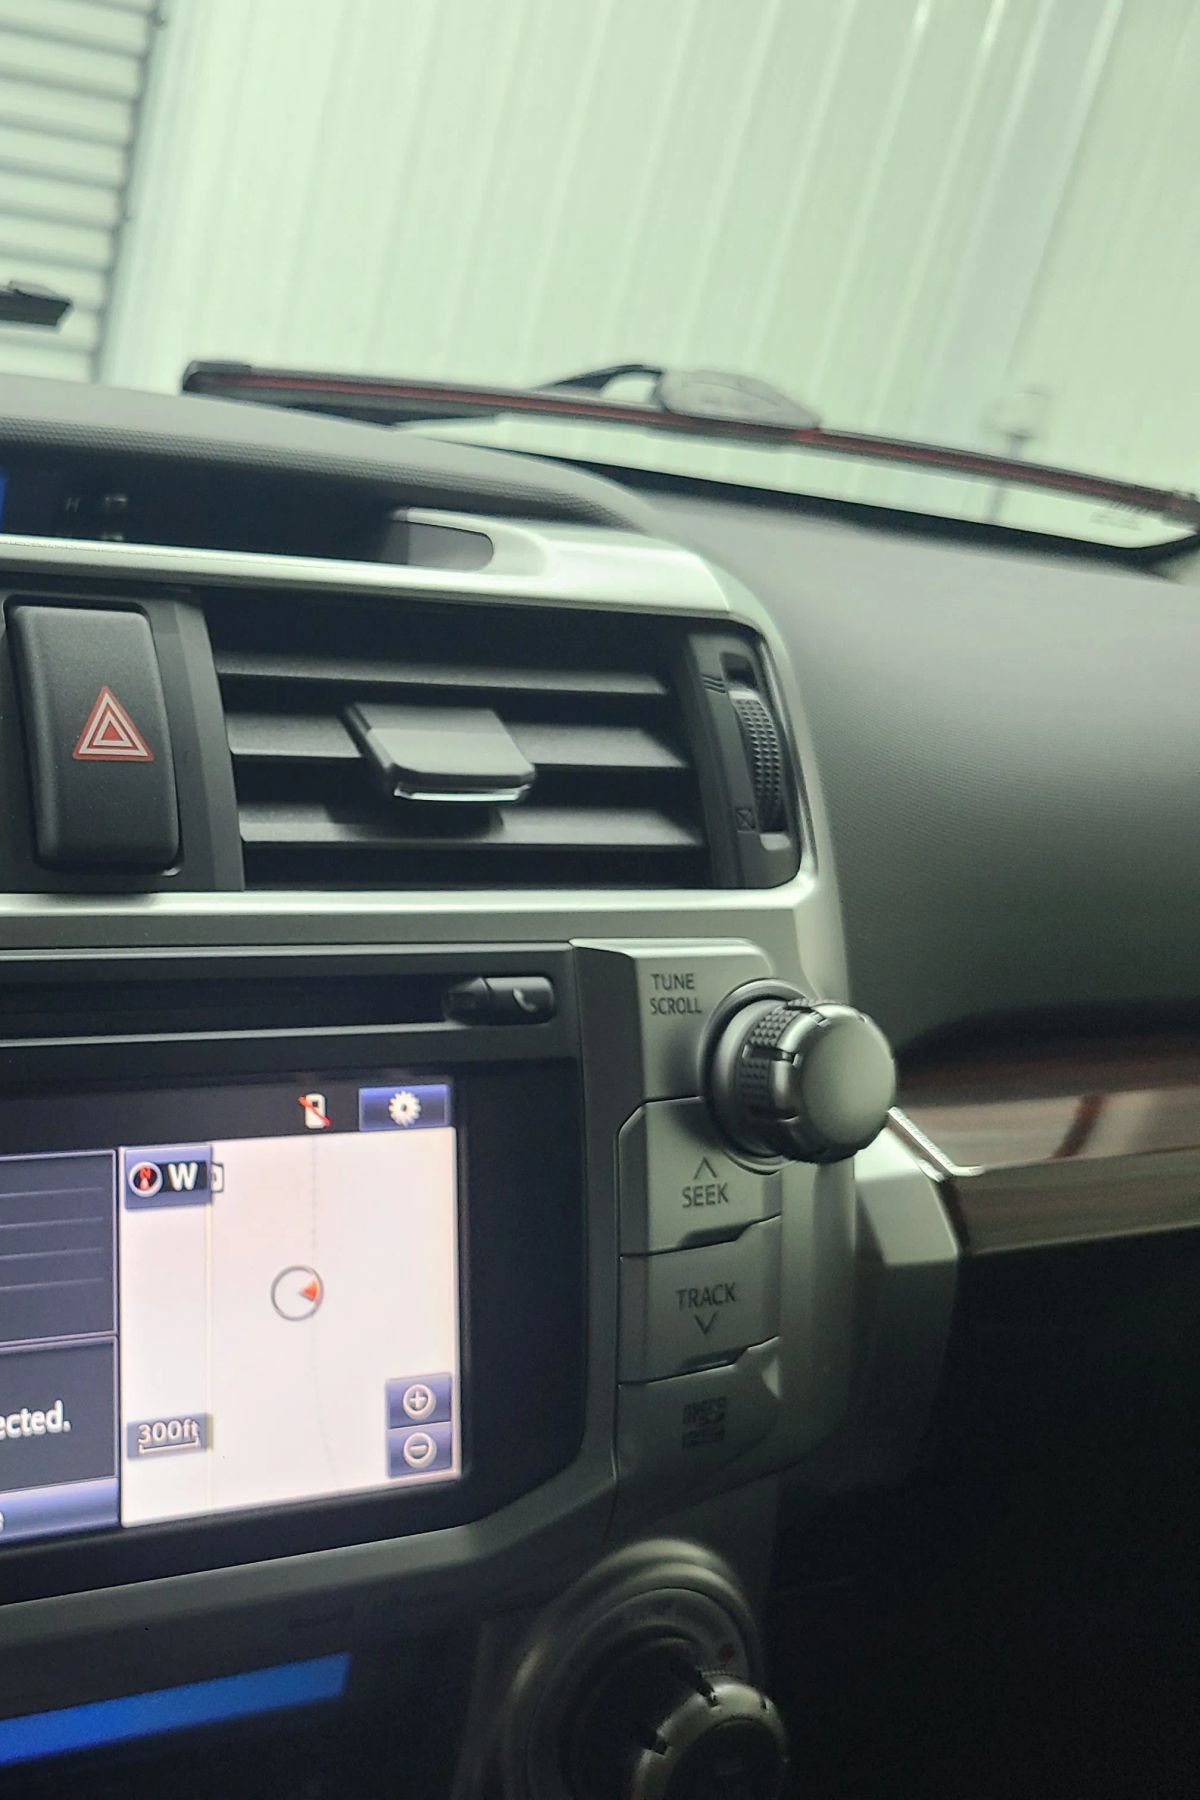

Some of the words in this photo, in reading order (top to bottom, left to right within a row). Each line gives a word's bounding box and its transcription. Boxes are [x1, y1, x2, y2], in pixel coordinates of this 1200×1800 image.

[651, 973, 695, 991] TUNE
[650, 996, 702, 1015] SCROLL
[167, 1162, 199, 1192] W
[682, 1183, 729, 1208] SEEK
[676, 1282, 736, 1309] TRACK
[137, 1417, 200, 1447] 300ft
